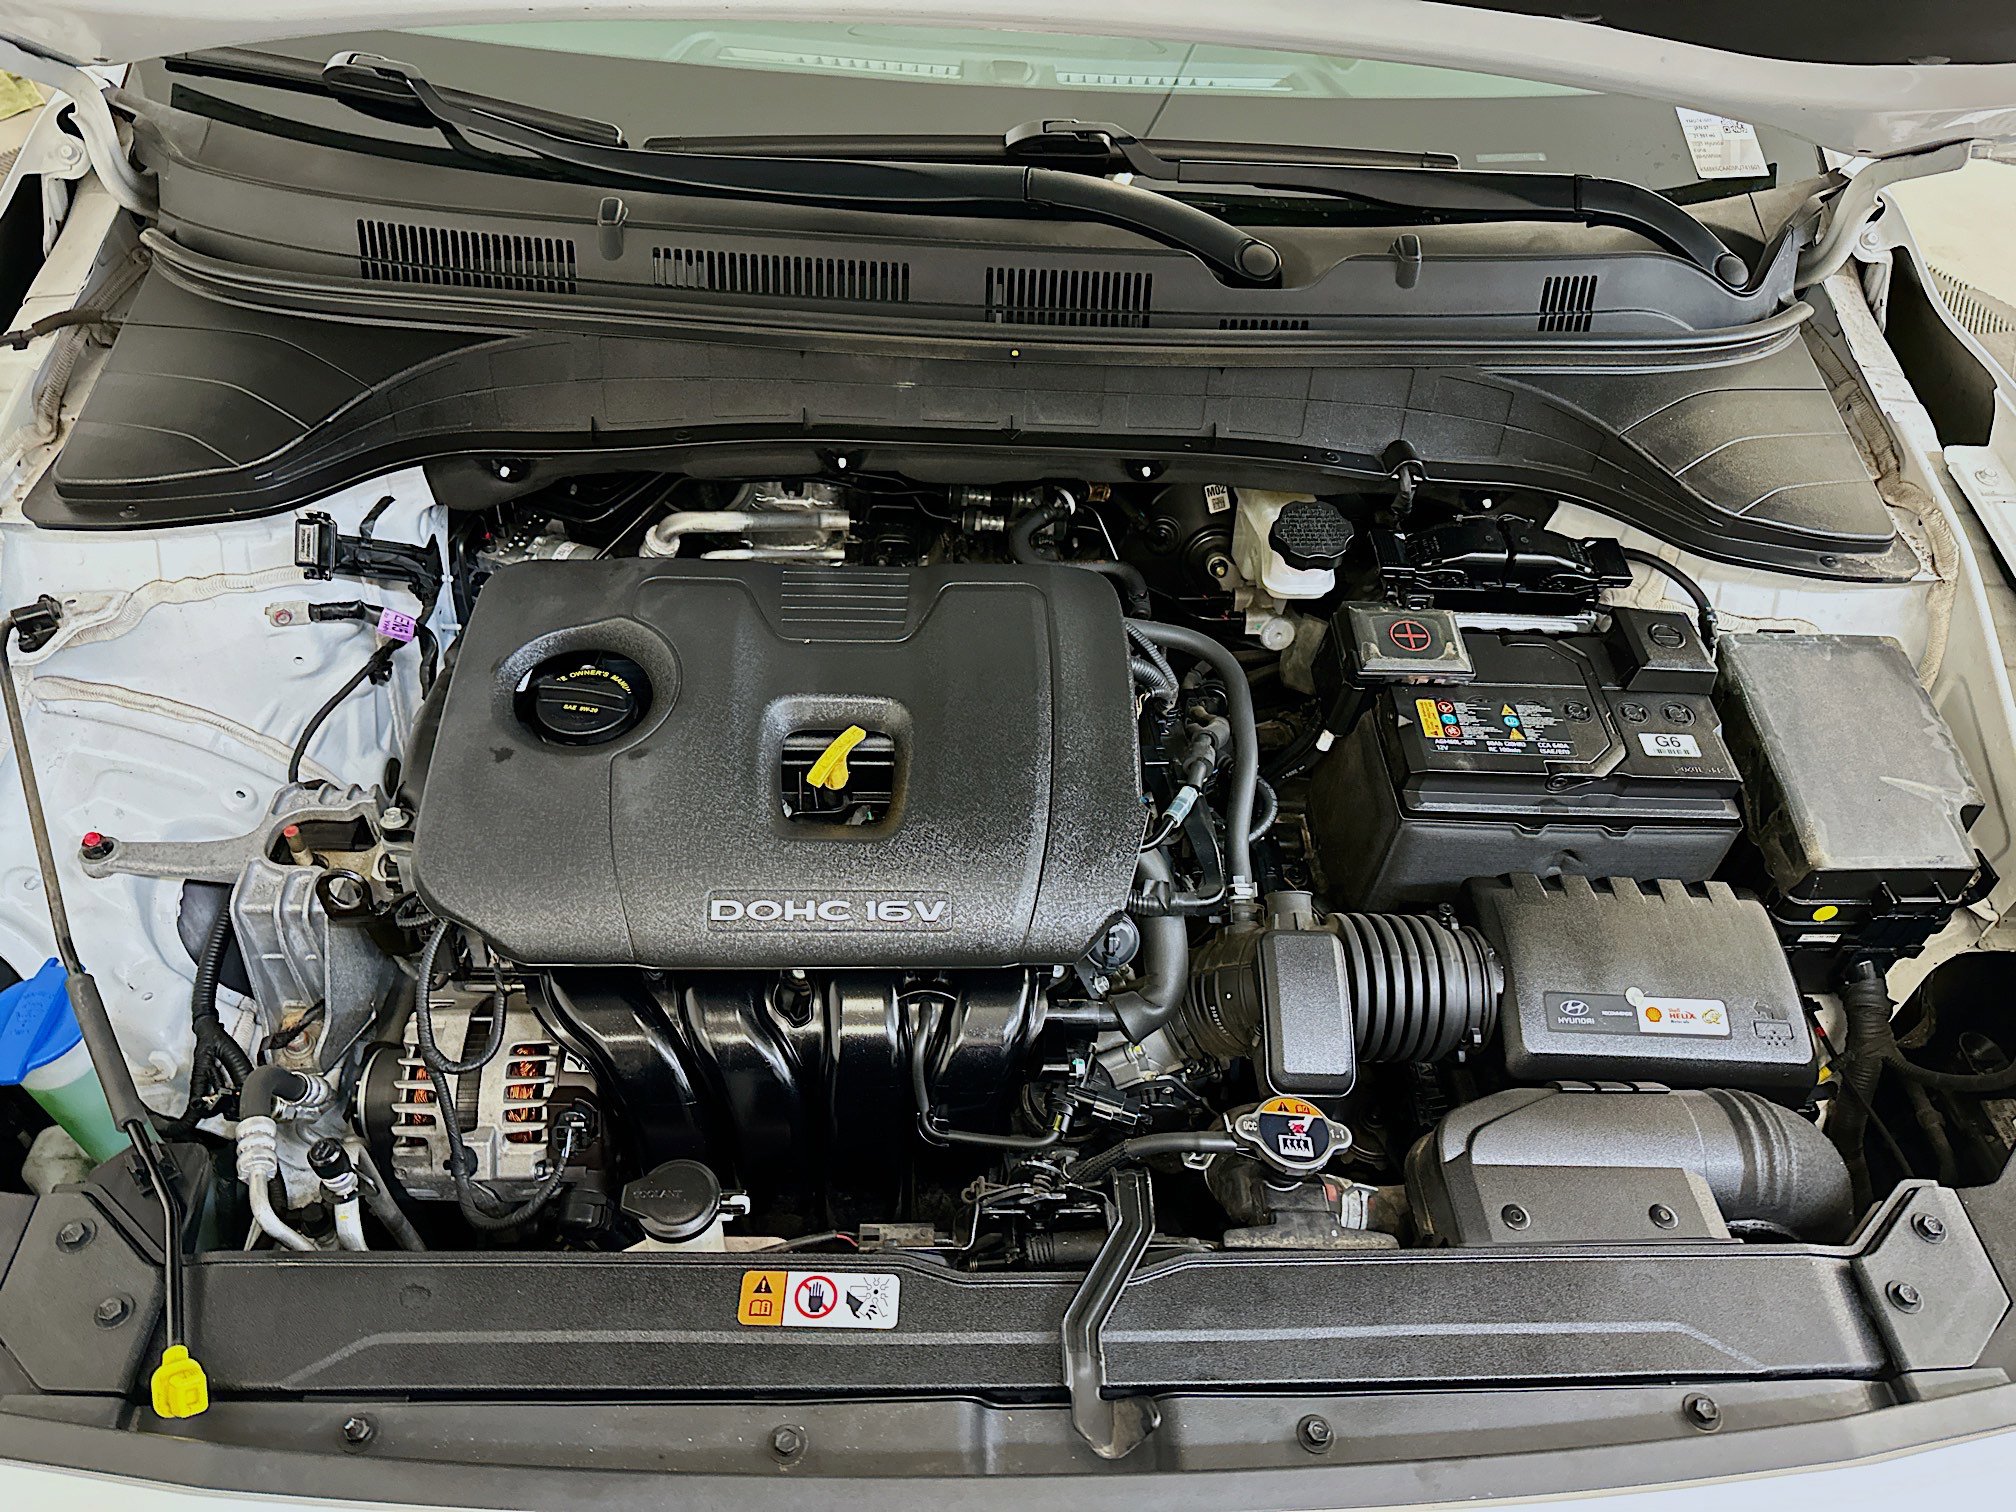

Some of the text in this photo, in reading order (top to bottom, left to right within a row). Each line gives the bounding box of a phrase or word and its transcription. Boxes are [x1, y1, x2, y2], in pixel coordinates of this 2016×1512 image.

[1206, 485, 1226, 497] M02
[569, 670, 609, 678] OWNER'S
[1655, 735, 1681, 748] G6
[710, 900, 947, 922] DOHC 16V
[1669, 1011, 1697, 1020] HELIX
[1558, 1017, 1595, 1025] HYUNDAI
[1329, 1129, 1345, 1139] 1.1
